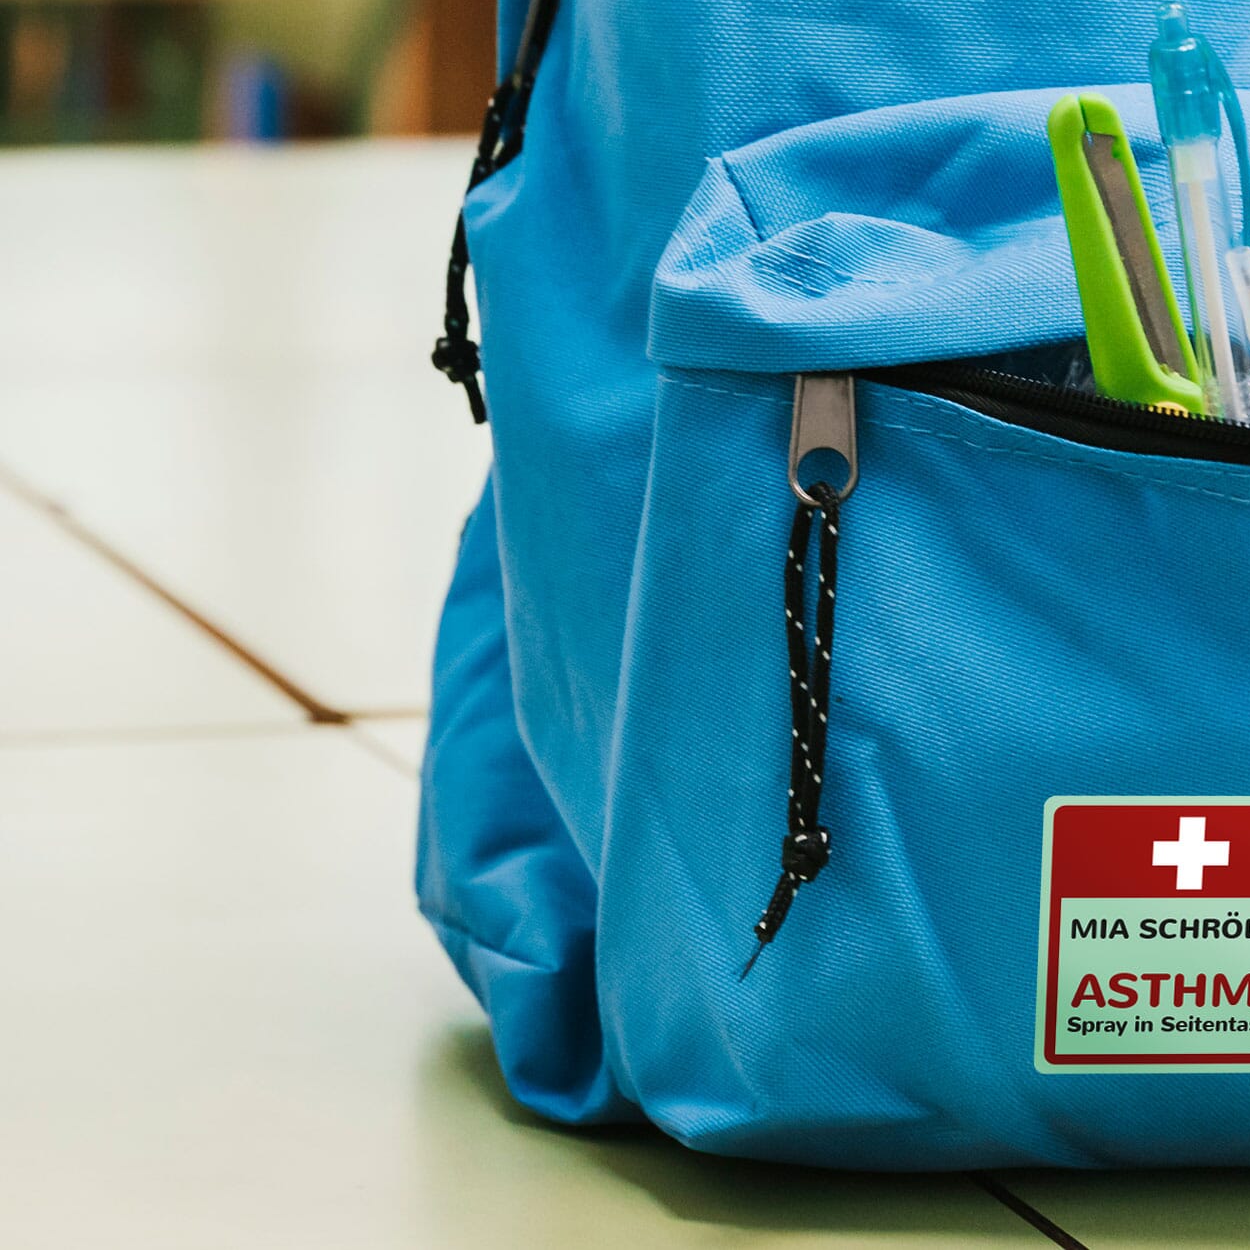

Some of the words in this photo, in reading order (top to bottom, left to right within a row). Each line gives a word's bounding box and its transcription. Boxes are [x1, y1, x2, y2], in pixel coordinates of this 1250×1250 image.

[1070, 918, 1130, 940] MIA
[1066, 1016, 1128, 1037] Spray
[1134, 1015, 1154, 1033] in
